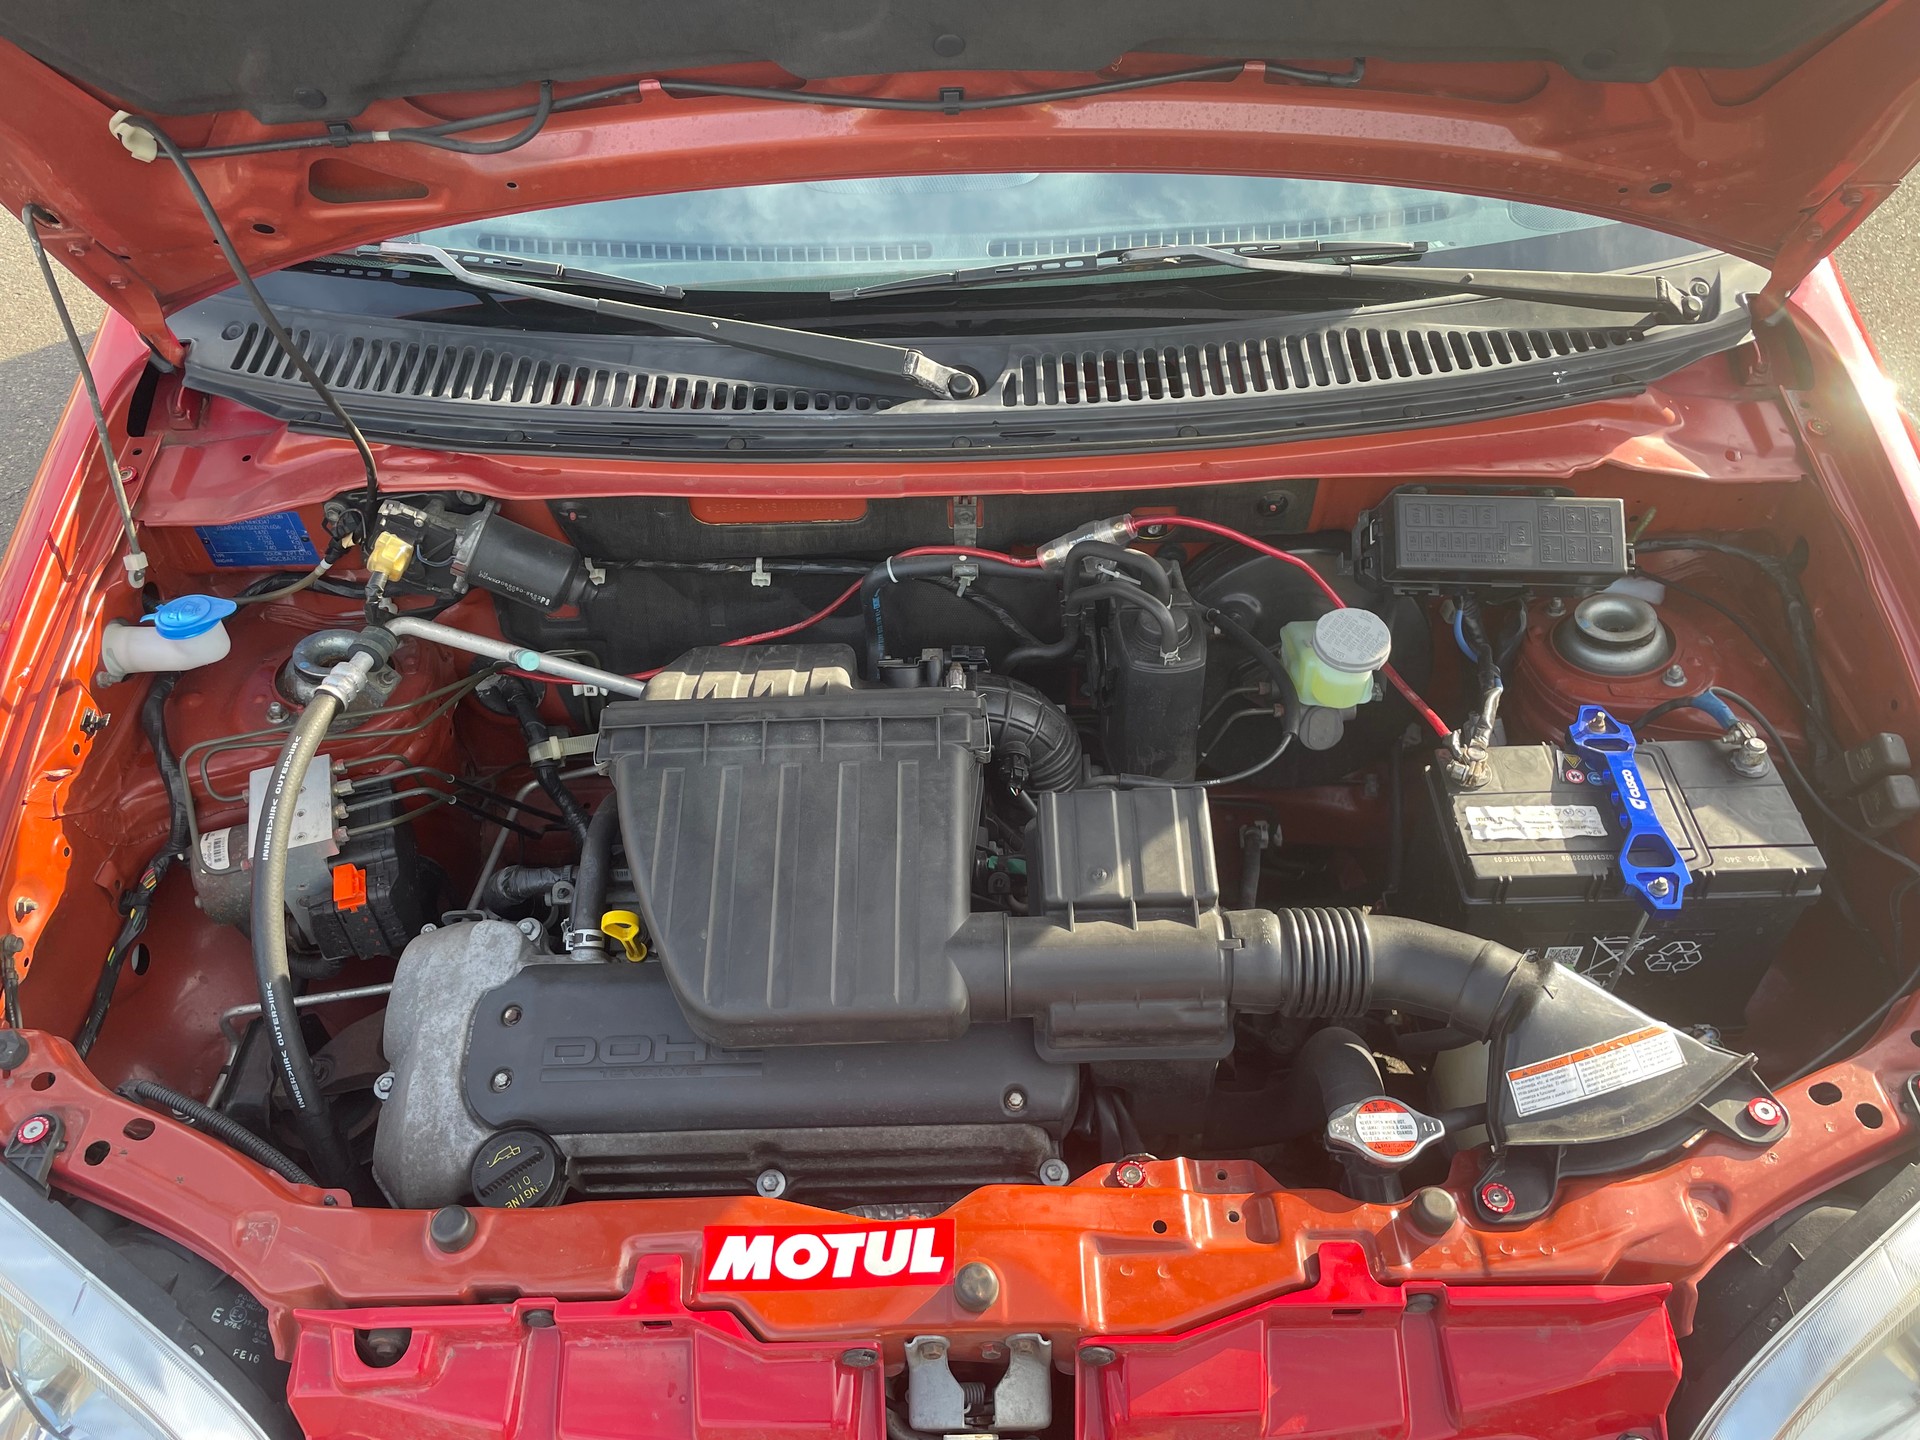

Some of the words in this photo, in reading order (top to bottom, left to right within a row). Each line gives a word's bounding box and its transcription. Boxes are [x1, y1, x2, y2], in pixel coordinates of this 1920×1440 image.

[505, 1180, 546, 1209] ENGINE
[508, 1175, 531, 1193] OIL
[708, 1227, 944, 1280] MOTUL
